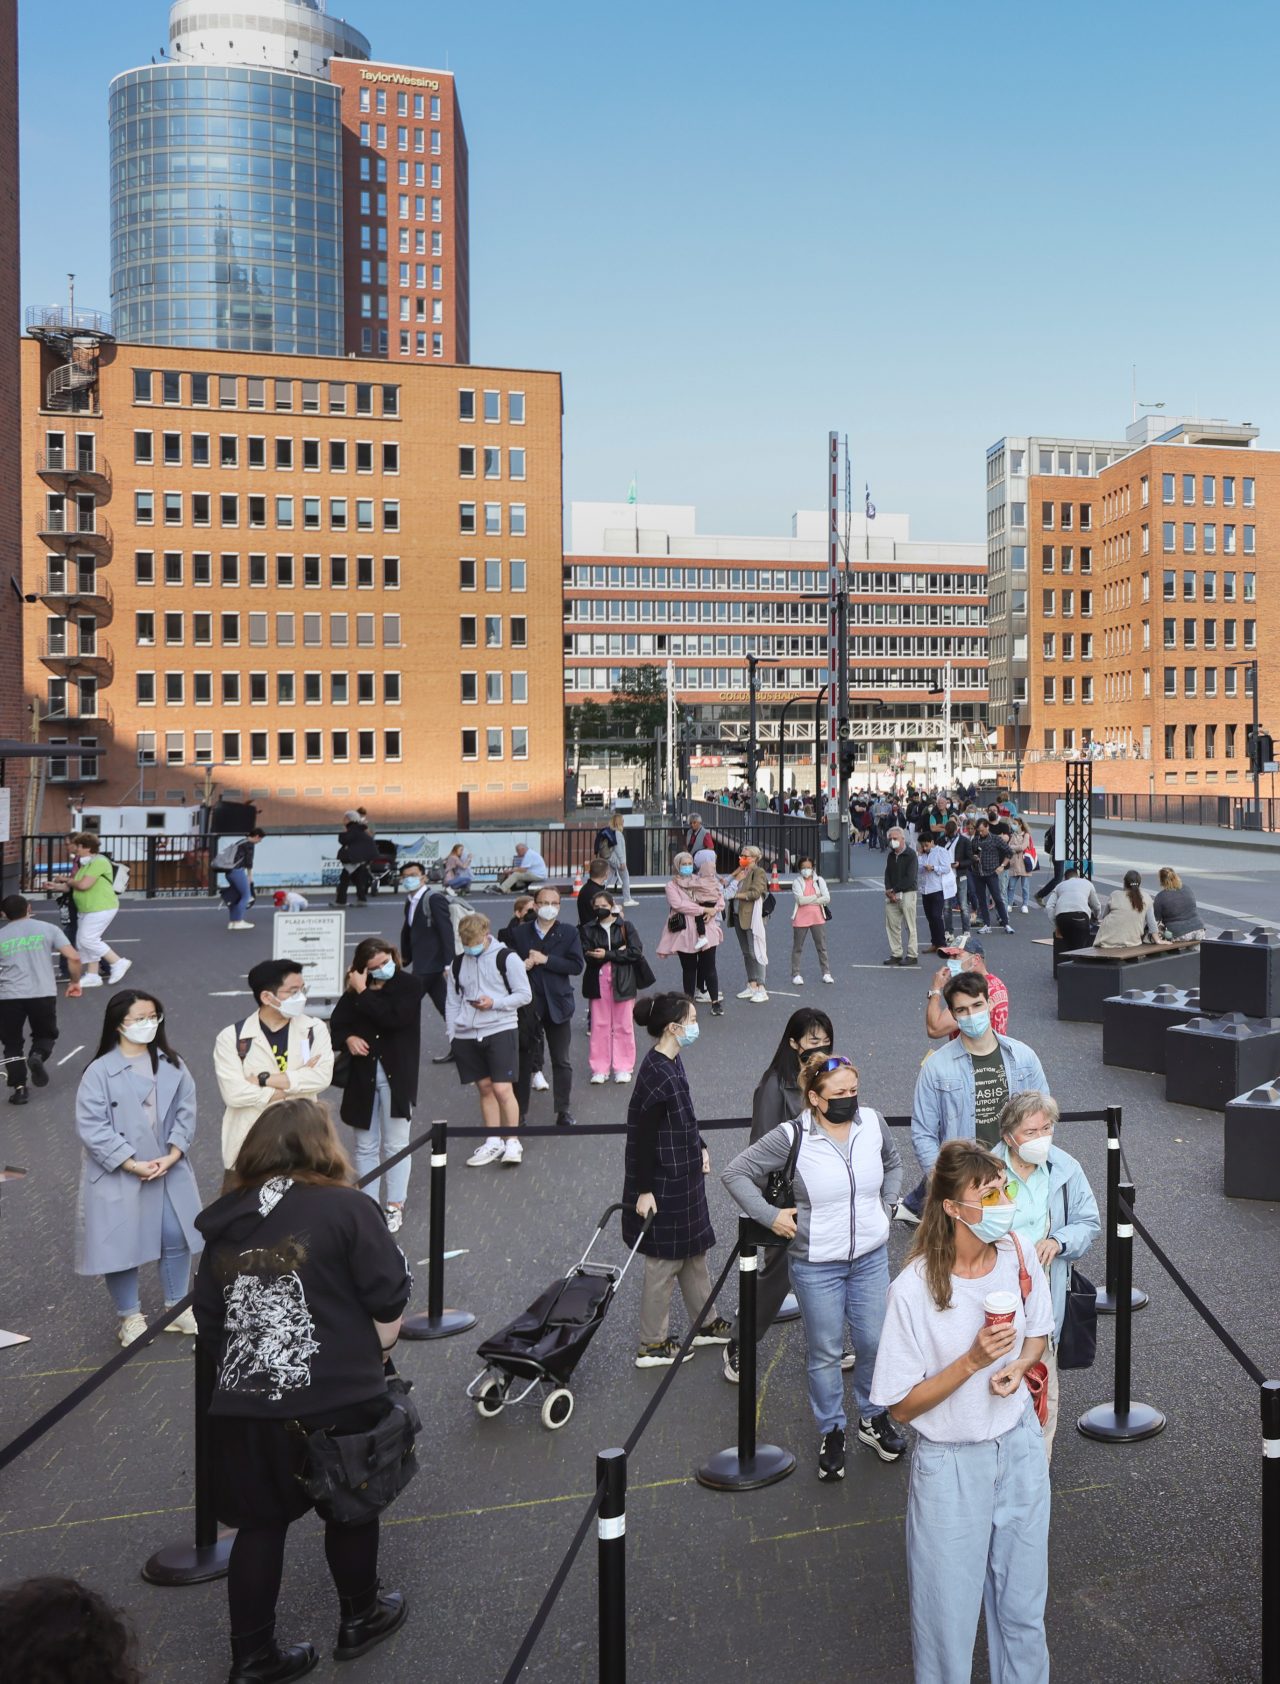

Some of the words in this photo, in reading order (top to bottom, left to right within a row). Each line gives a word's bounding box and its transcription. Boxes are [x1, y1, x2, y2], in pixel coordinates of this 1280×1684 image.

[360, 69, 439, 91] TaylorWessing
[976, 1087, 1003, 1099] ASIS
[975, 1098, 1000, 1106] UTPOST
